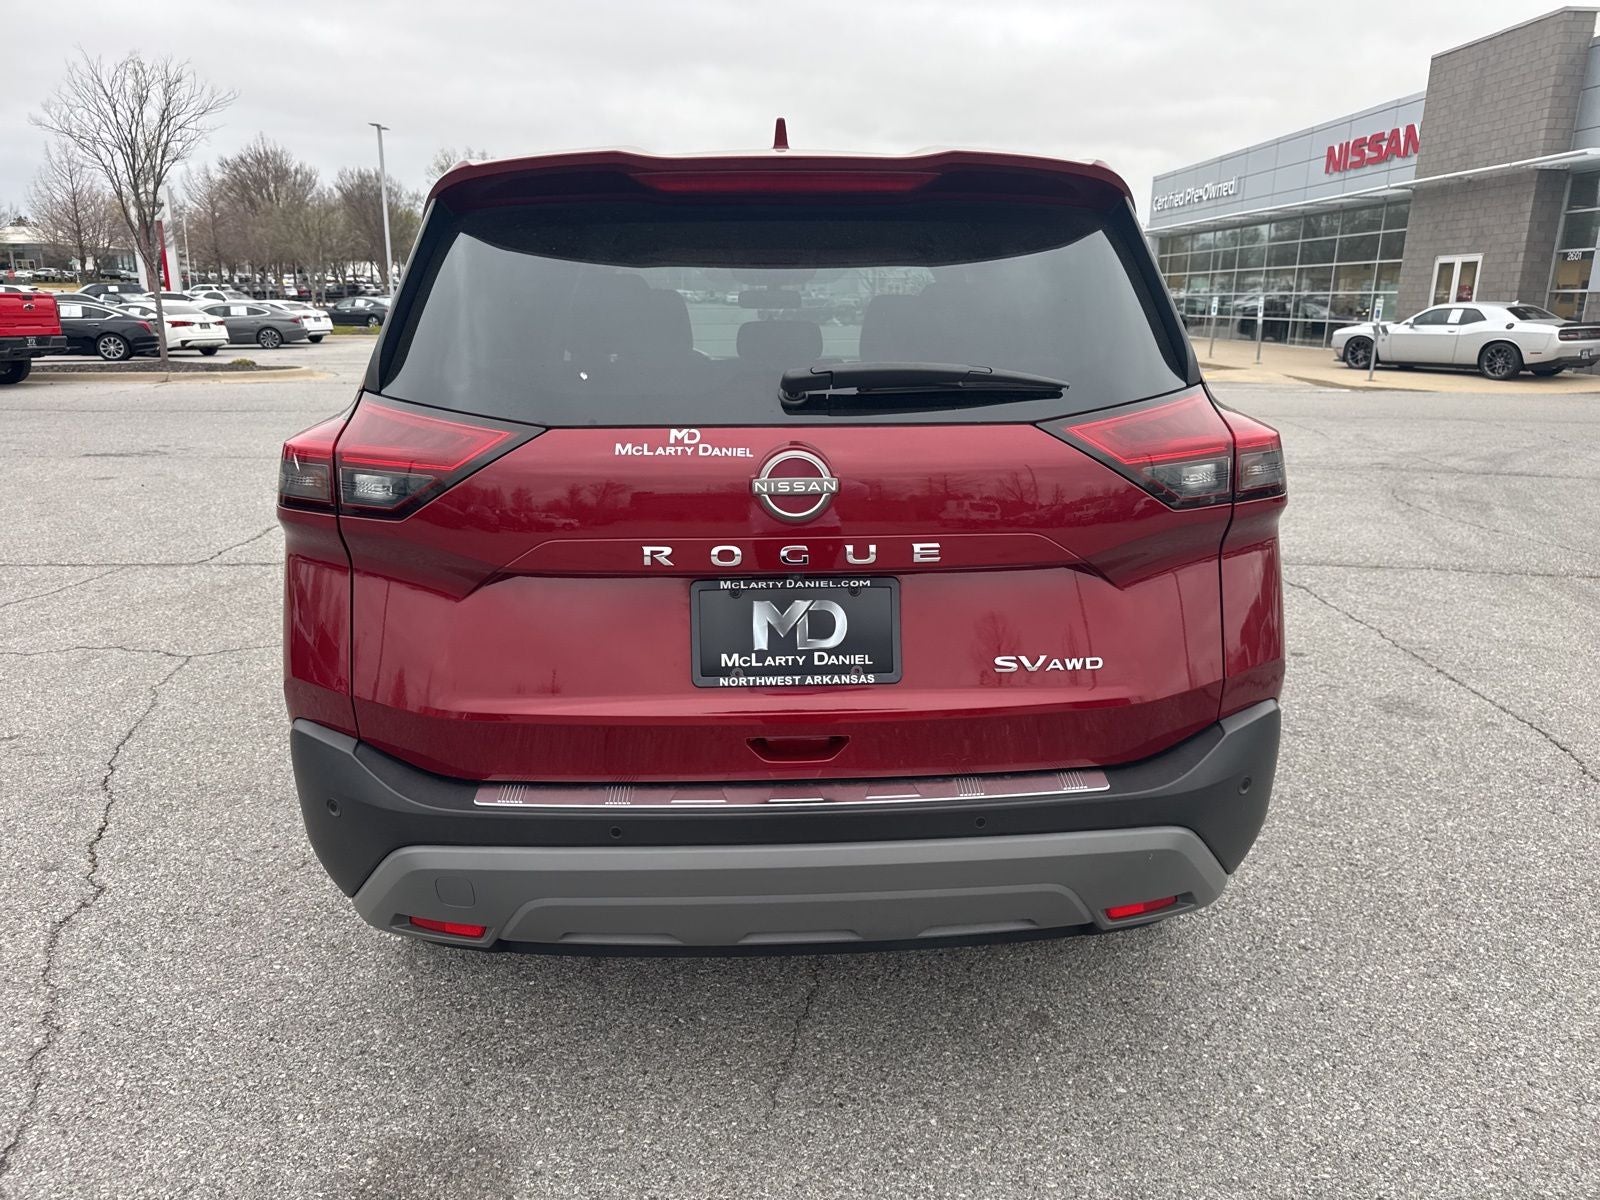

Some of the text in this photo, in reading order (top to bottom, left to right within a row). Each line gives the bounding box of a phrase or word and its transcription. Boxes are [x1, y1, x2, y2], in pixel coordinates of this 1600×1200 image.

[1324, 122, 1421, 175] NISSAN
[1153, 176, 1237, 212] Certified Pre-Owned
[698, 443, 754, 458] DANIEL
[754, 480, 837, 493] NISSAN
[641, 542, 942, 567] ROGUE
[752, 599, 848, 651] MD
[813, 651, 874, 666] DANIEL
[720, 674, 875, 687] NORTHWEST ARKANSAS
